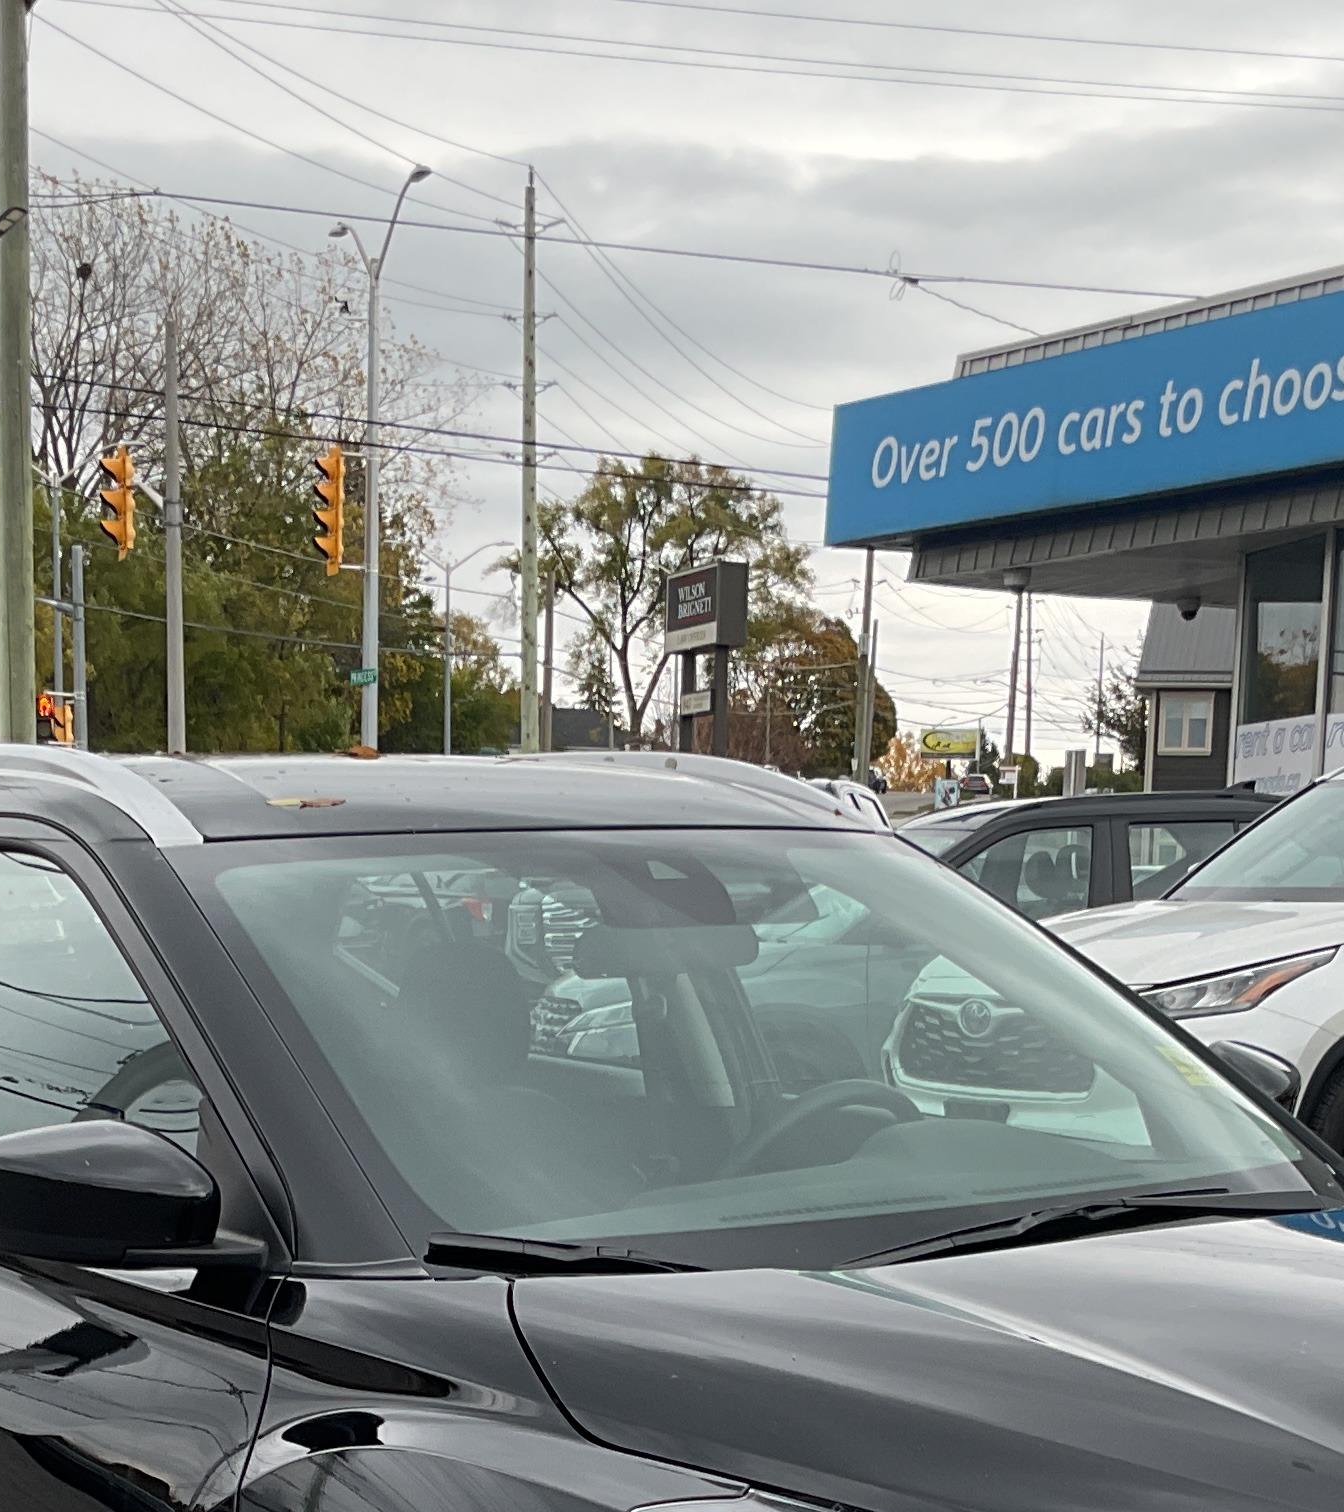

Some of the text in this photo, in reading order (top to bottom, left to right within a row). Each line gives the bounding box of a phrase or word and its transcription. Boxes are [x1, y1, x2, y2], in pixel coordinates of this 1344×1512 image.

[871, 436, 958, 489] Over
[966, 407, 1046, 472] 500
[1058, 400, 1144, 455] cars
[1159, 379, 1203, 438] to
[678, 581, 706, 602] WILSON
[1236, 723, 1270, 759] rent
[1273, 728, 1287, 755] a
